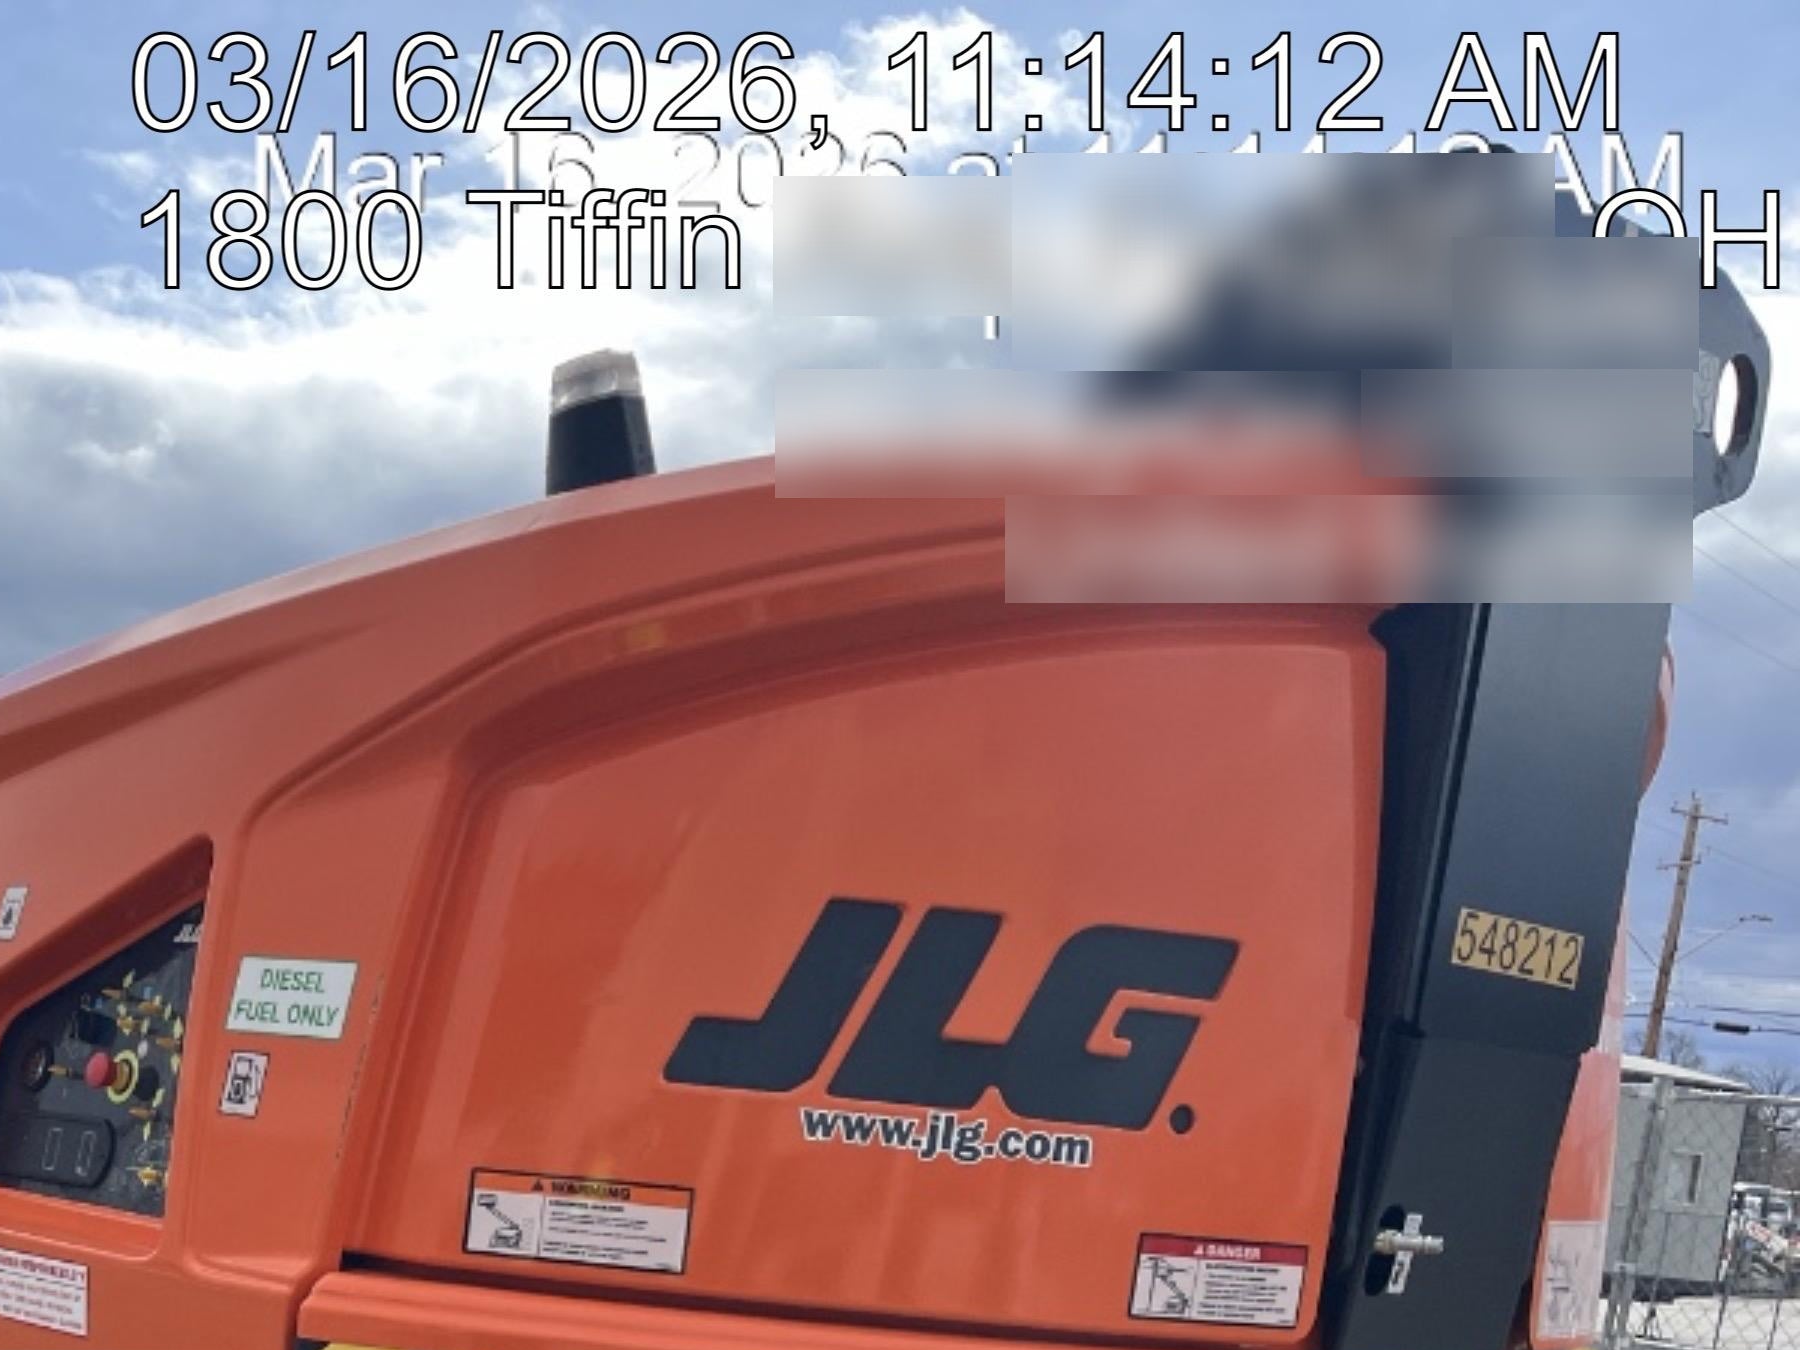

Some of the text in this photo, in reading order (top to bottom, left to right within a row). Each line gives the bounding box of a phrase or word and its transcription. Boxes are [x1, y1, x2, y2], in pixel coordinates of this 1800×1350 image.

[1455, 911, 1582, 985] 548212
[260, 968, 326, 993] DIESEL
[234, 1000, 339, 1027] FUEL ONLY
[802, 1106, 1093, 1167] www.jlg.com
[551, 1180, 631, 1201] WARNING
[1206, 1244, 1262, 1261] DANGER
